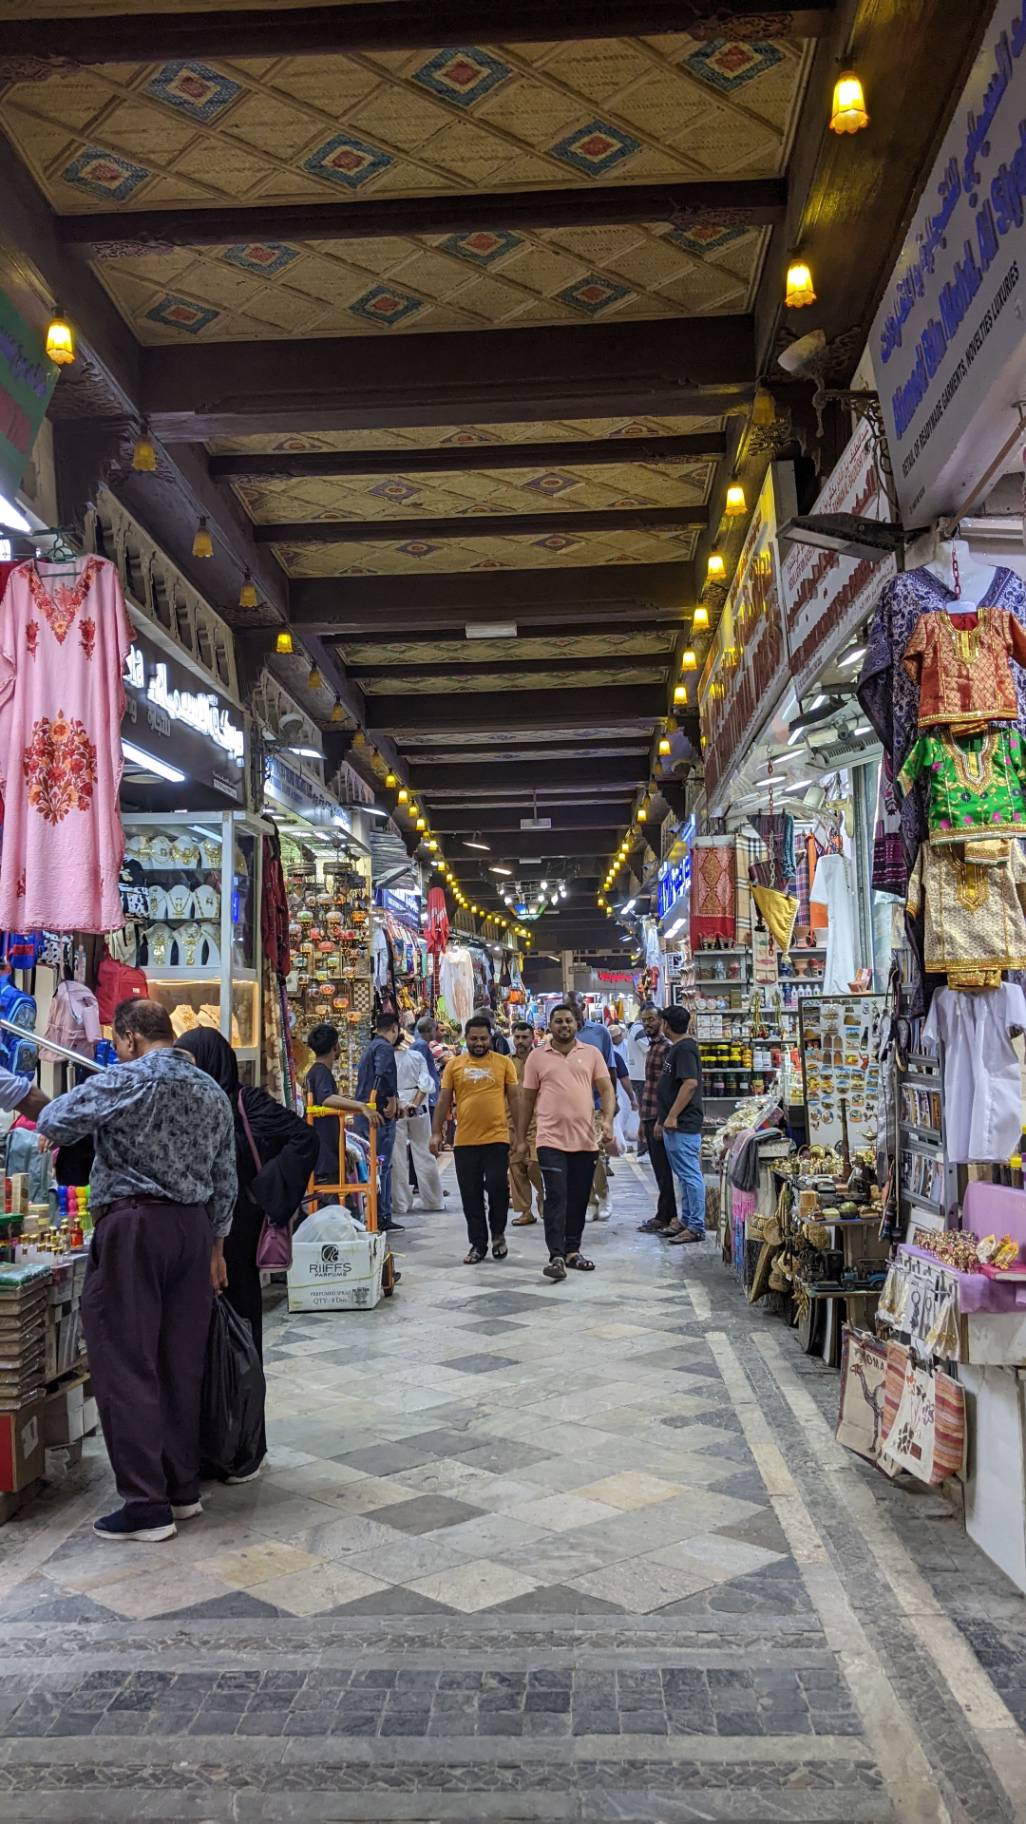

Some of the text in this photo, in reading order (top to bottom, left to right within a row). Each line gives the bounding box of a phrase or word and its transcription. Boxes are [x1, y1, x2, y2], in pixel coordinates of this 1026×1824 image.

[976, 198, 999, 273] Al
[902, 449, 915, 478] RETAIL
[914, 438, 920, 458] OF
[919, 399, 943, 450] READYMADE
[942, 358, 968, 410] GARMENTS,
[965, 308, 993, 368] NOVELTIES
[991, 259, 1019, 321] LUXURIES
[309, 1262, 352, 1273] RIIFFS
